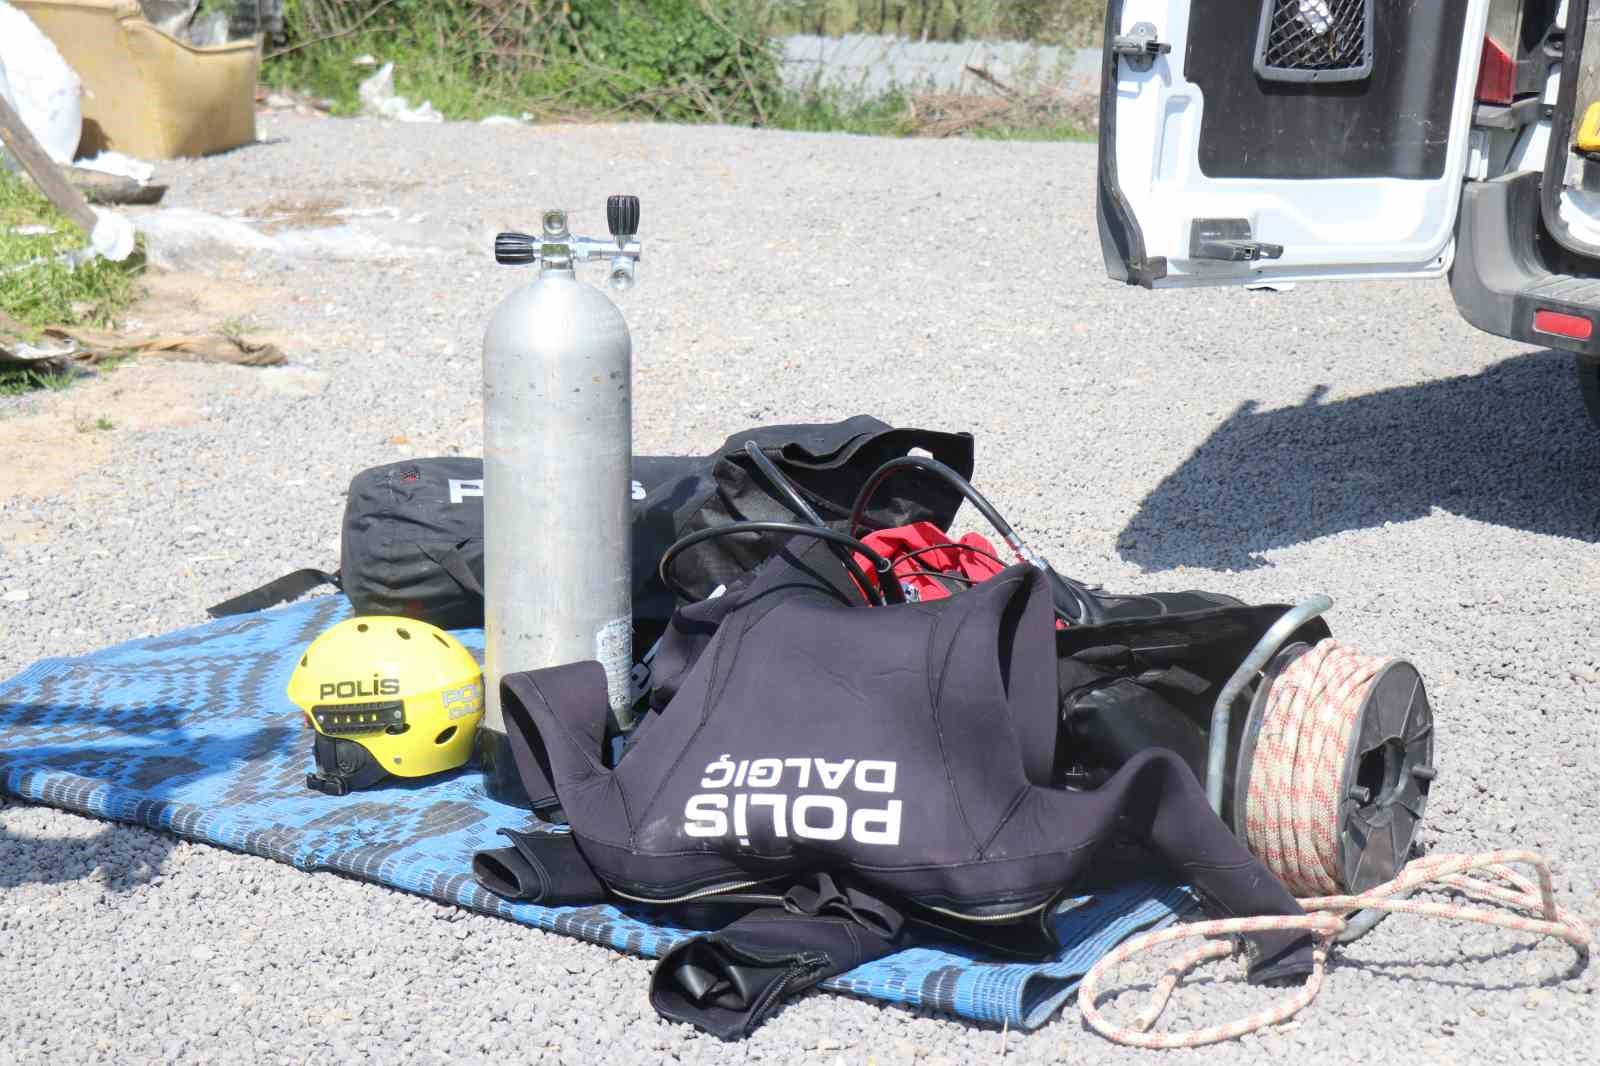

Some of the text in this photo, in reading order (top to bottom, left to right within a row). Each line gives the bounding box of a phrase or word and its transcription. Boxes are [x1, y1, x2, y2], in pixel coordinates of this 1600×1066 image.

[320, 673, 400, 700] POLİS
[700, 754, 897, 793] DALGIÇ
[684, 793, 902, 846] POLİS
